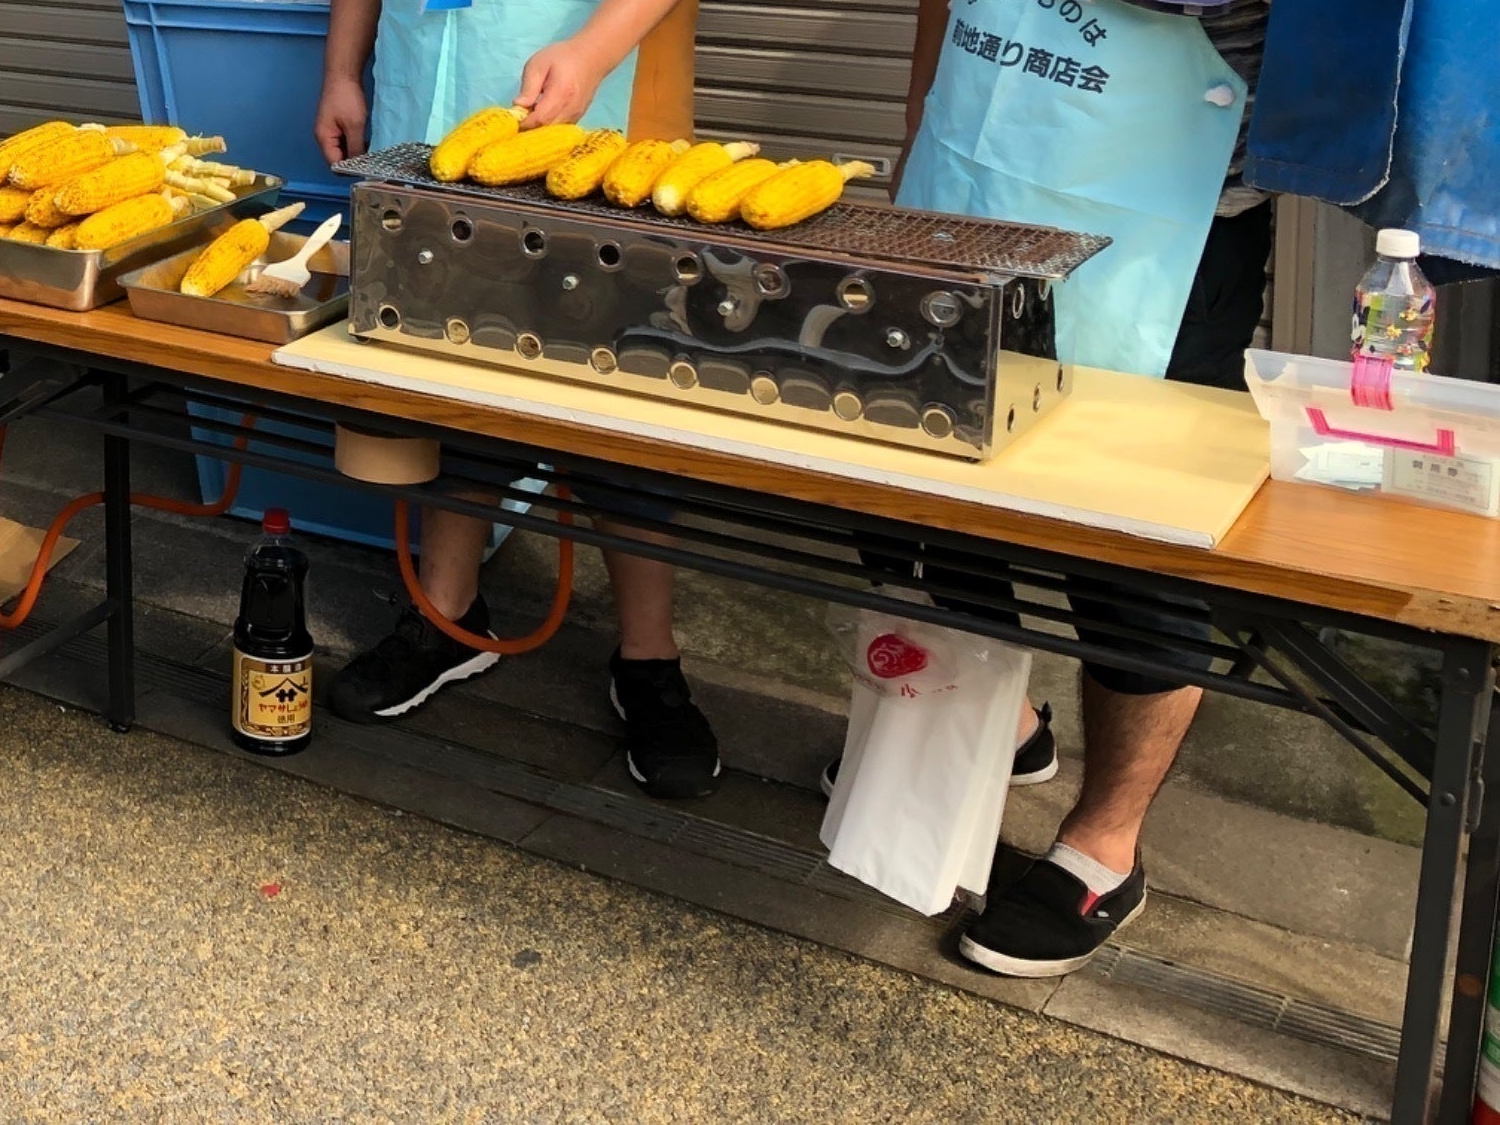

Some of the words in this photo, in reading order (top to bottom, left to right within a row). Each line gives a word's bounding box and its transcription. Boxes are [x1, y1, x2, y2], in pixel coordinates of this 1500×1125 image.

[952, 18, 1110, 93] 前地通り商店会
